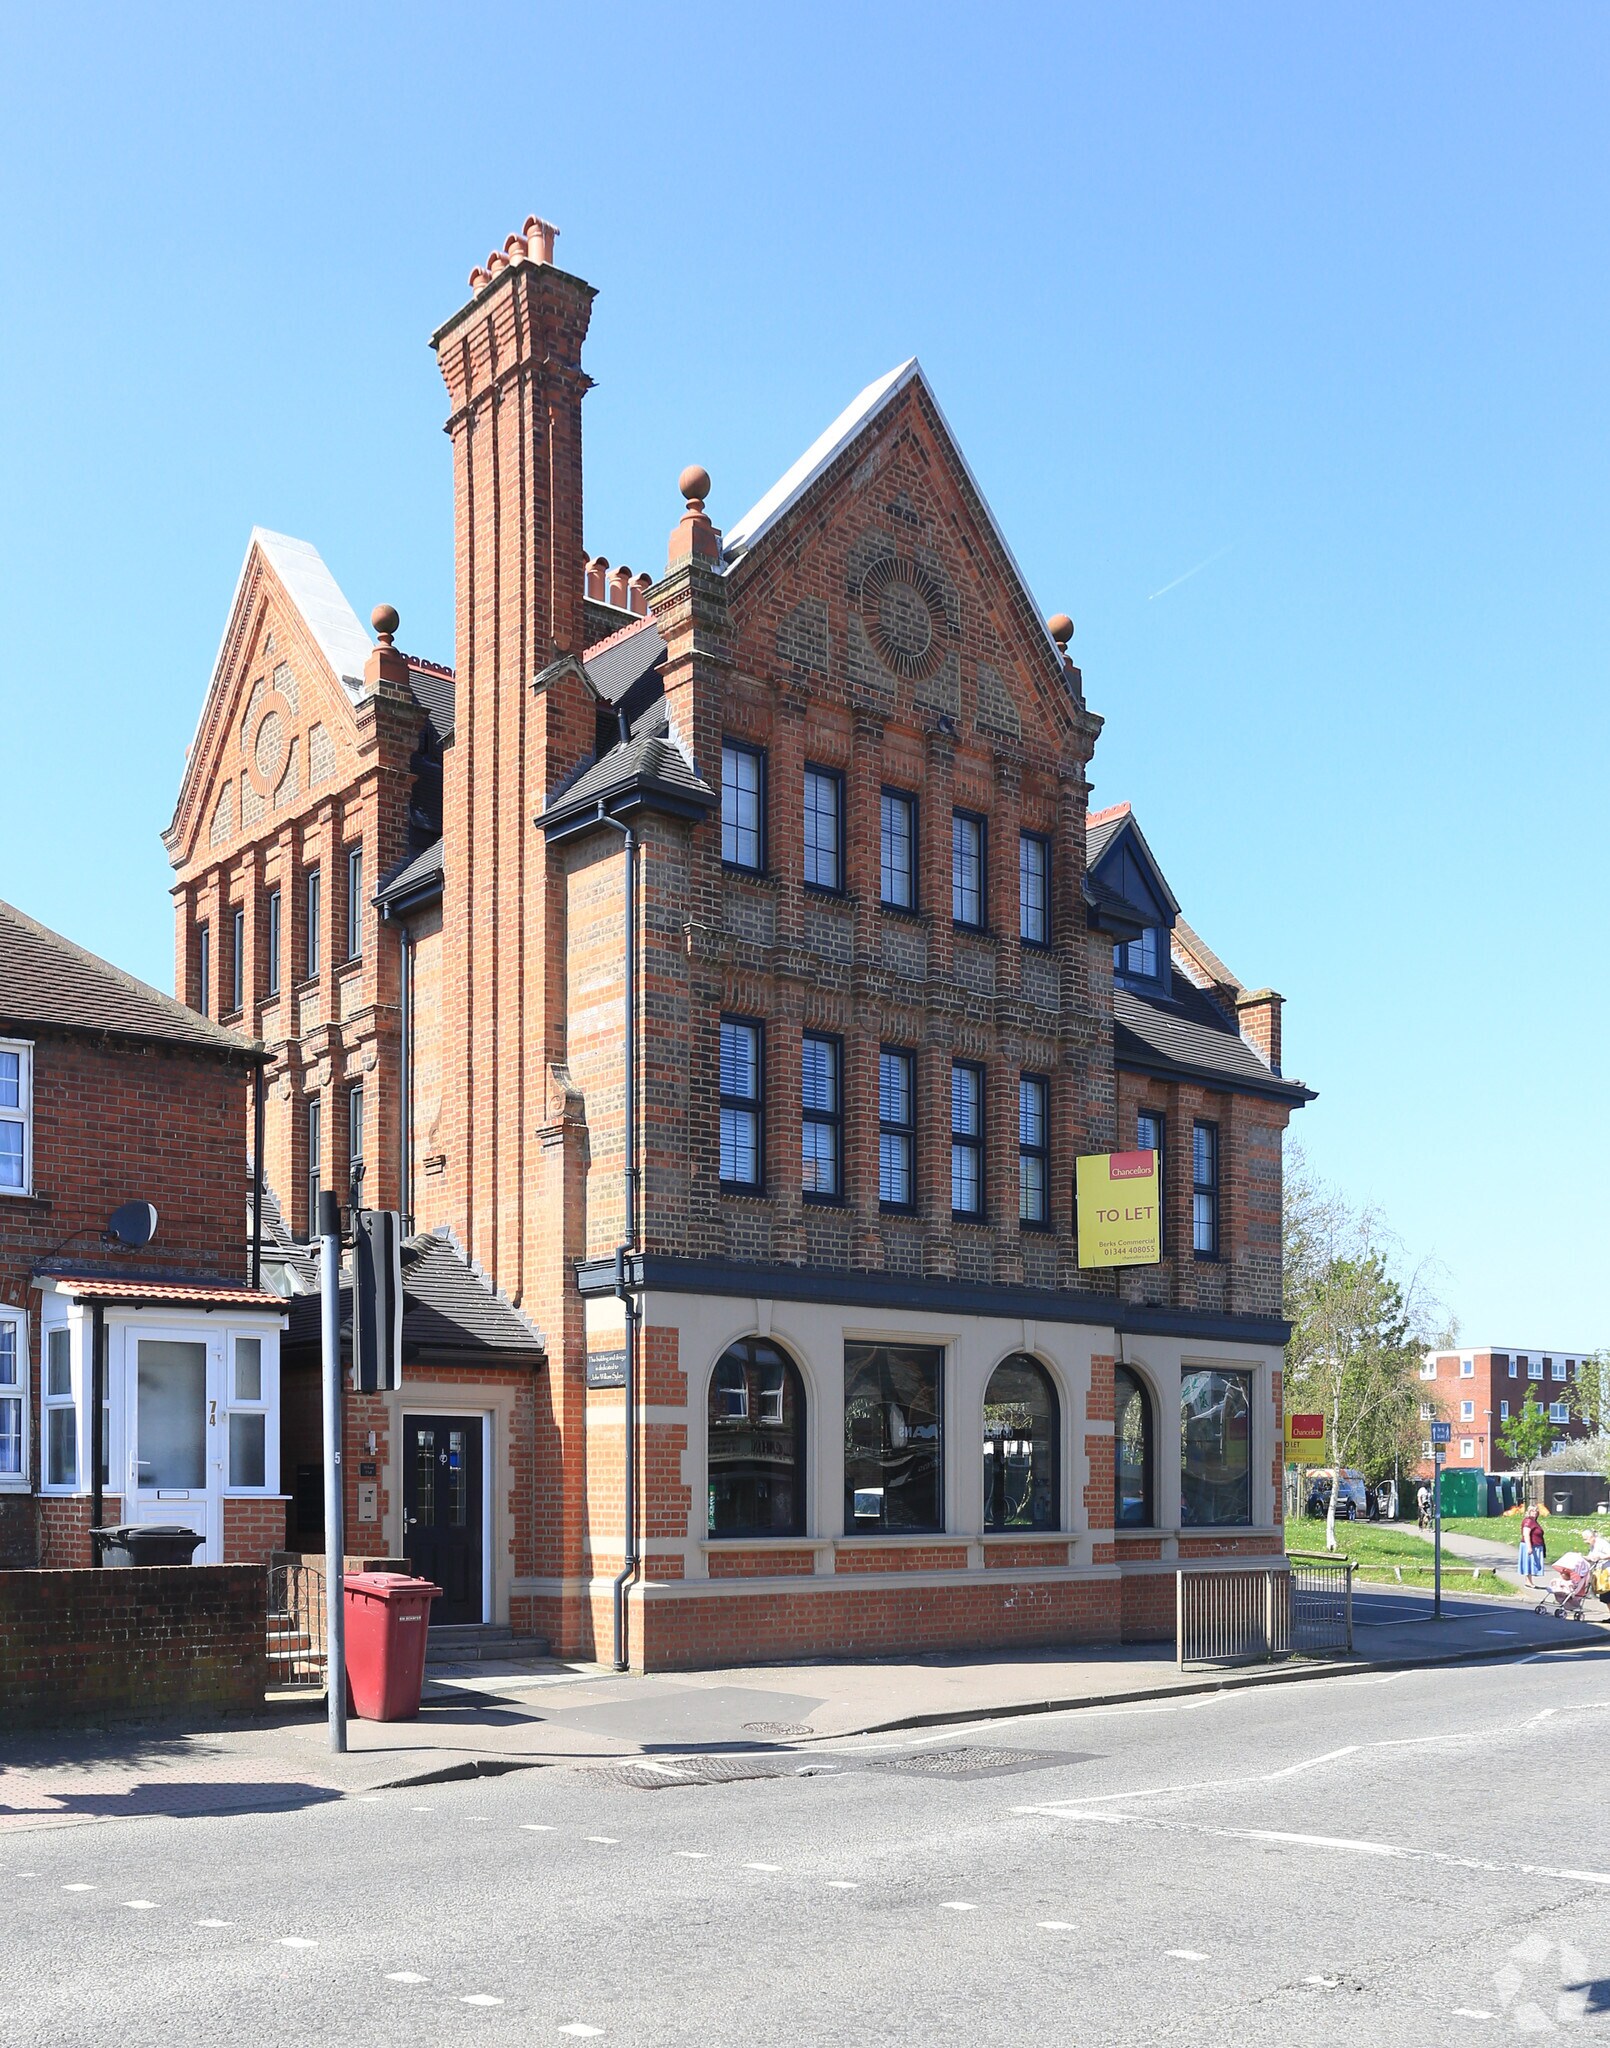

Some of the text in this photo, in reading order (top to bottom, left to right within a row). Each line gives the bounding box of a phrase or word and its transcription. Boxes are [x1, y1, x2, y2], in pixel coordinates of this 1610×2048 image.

[1112, 1166, 1152, 1176] Chancellors
[1096, 1206, 1154, 1222] TO LET
[1098, 1238, 1156, 1248] Berks Commercial
[1104, 1246, 1155, 1256] 01344 408055
[209, 1400, 217, 1427] 74
[1293, 1428, 1321, 1436] Chancellors
[334, 1452, 340, 1464] 5
